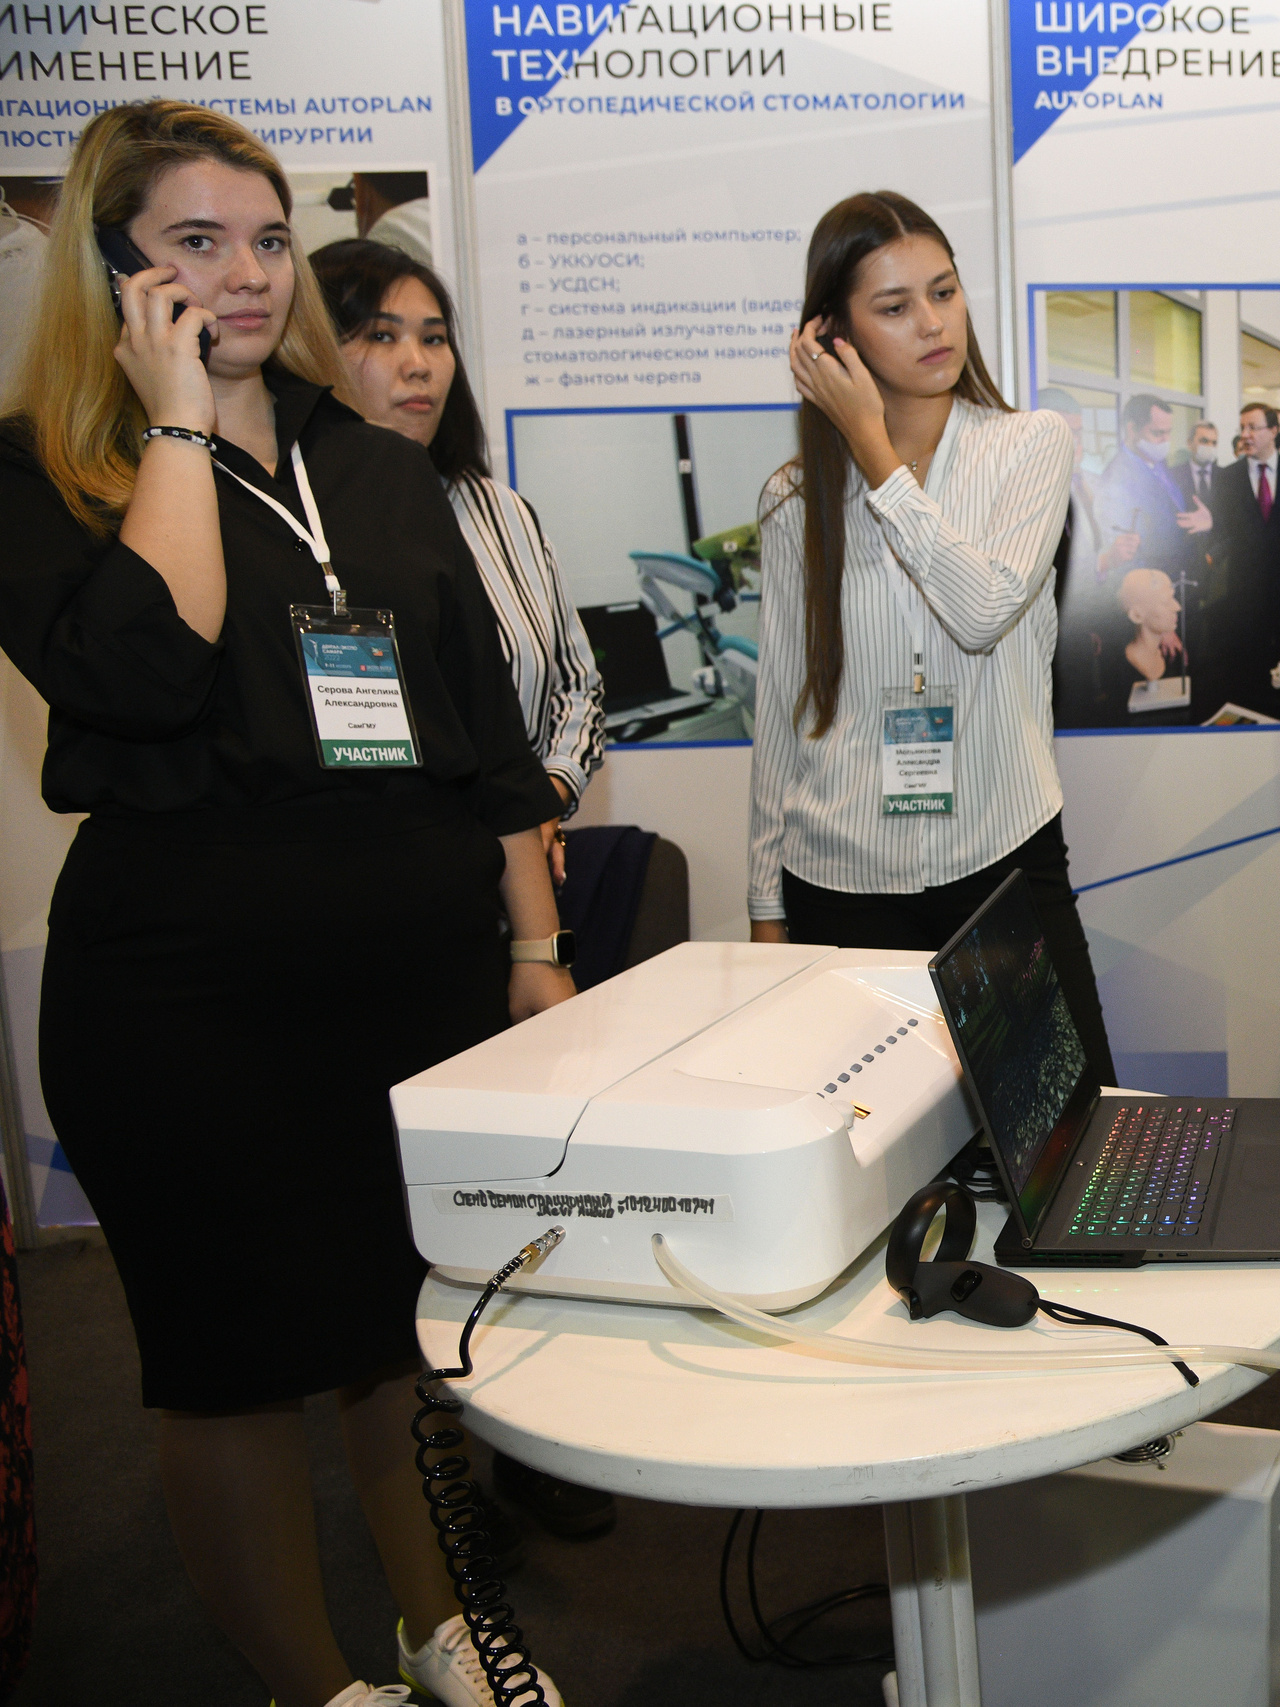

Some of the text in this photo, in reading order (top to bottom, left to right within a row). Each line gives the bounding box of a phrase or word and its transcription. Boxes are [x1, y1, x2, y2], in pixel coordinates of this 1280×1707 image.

[492, 3, 894, 39] НАВИГАЦИОННЫЕ
[1034, 2, 1251, 34] ШИРОКОЕ
[0, 51, 252, 81] ИМЕНЕНИЕ
[492, 48, 787, 82] ТЕХНОЛОГИИ
[304, 96, 433, 115] AUTOPLAN
[495, 90, 966, 117] В ОРТОПЕДИЧЕСКОЙ СТОМАТОЛОГИИ
[1034, 91, 1164, 110] AUTOPLAN
[254, 127, 374, 146] ИРУРГИИ
[546, 227, 687, 247] персональный
[692, 227, 802, 245] компьютер;
[549, 303, 626, 317] система
[631, 300, 737, 316] индикации
[553, 324, 646, 341] лазерный
[651, 323, 758, 342] излучатель
[762, 322, 784, 336] на
[523, 347, 710, 365] стоматологическом
[558, 370, 629, 389] фантом
[633, 370, 703, 387] черепа
[317, 685, 400, 696] Серова Ангелина
[324, 698, 398, 710] Александровна
[333, 747, 408, 762] УЧАСТНИК
[888, 799, 945, 813] УЧАСТНИК
